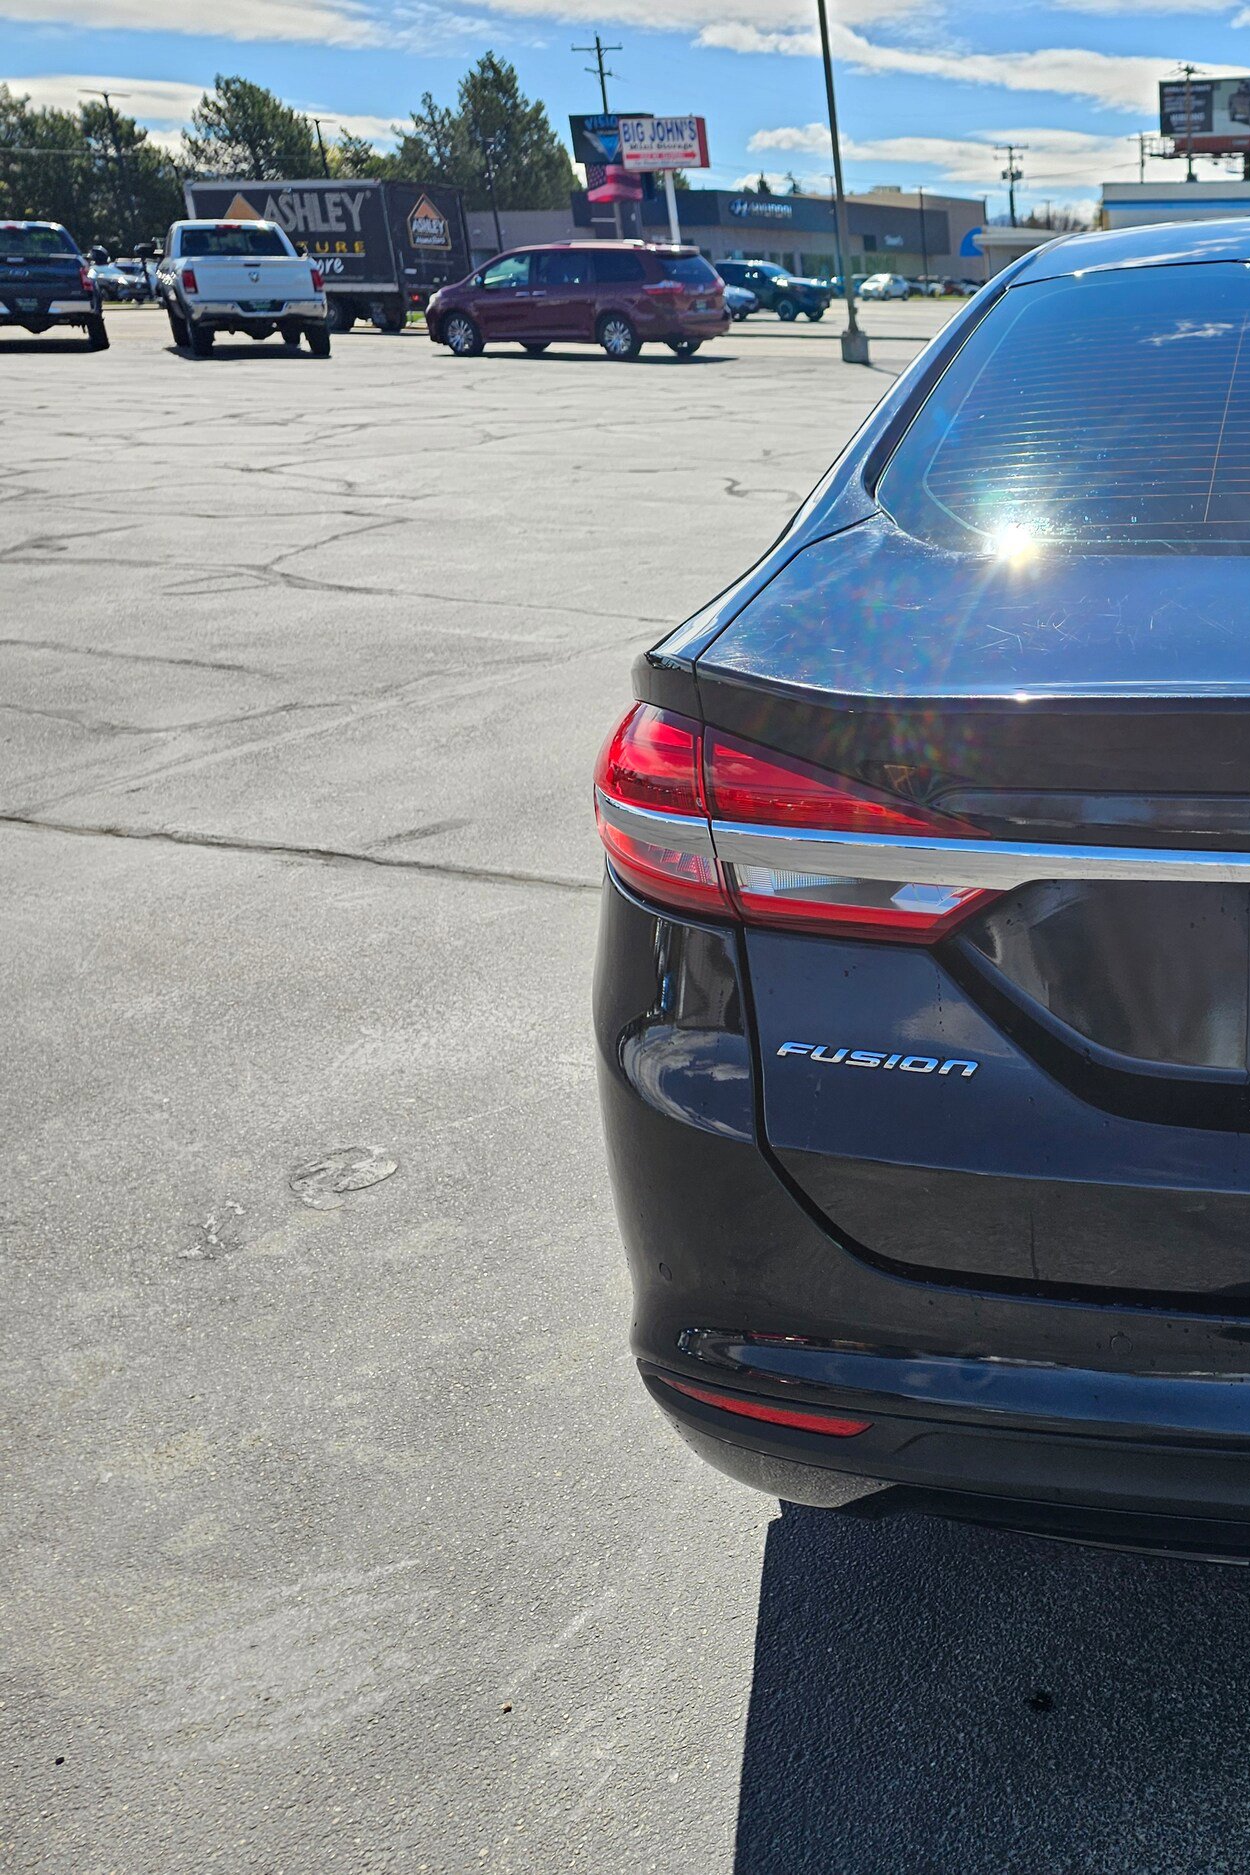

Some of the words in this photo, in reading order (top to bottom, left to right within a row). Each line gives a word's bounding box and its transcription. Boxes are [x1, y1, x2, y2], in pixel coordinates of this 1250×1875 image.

[622, 121, 645, 143] BIG
[649, 120, 697, 143] JOHN'S
[263, 191, 365, 233] ASHLEY
[776, 1040, 980, 1078] FUSION
